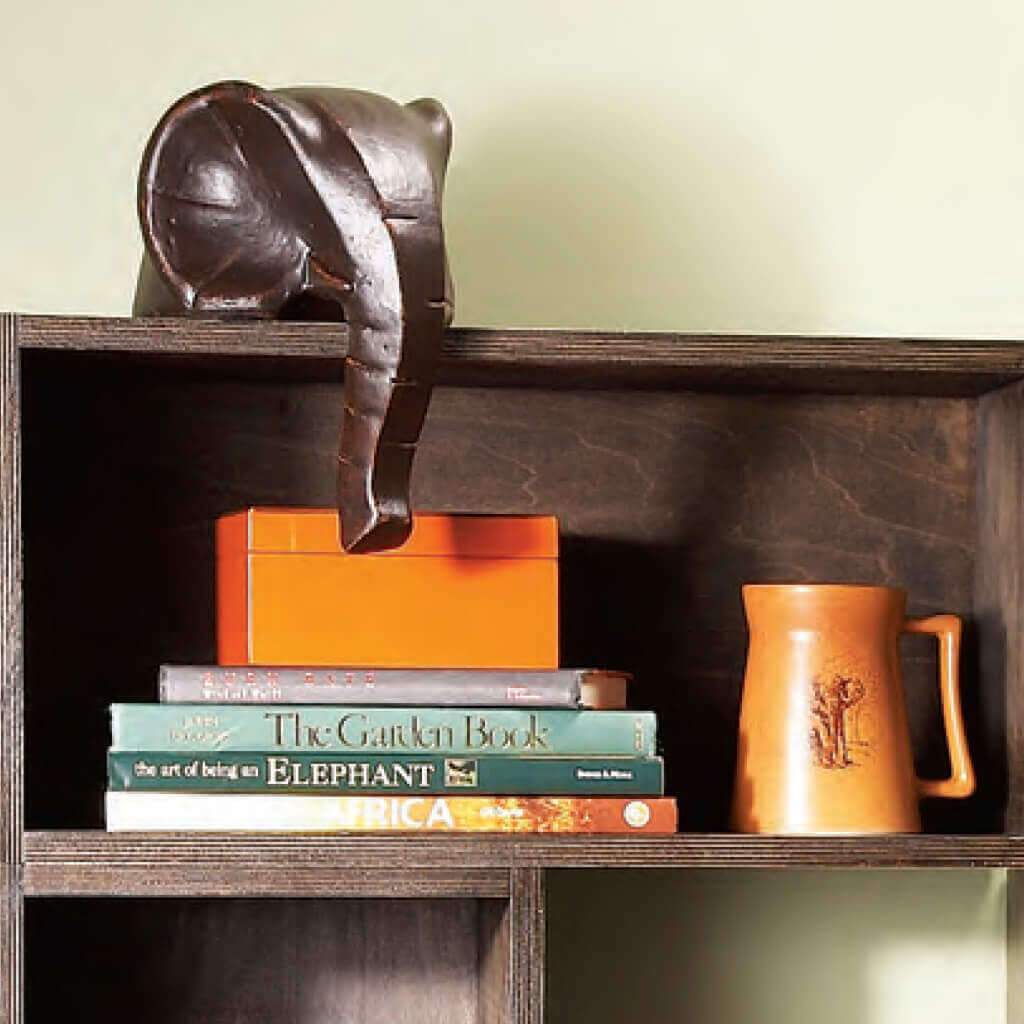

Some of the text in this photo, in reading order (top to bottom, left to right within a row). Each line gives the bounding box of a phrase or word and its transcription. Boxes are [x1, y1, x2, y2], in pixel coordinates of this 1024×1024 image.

[264, 711, 331, 747] The
[337, 711, 454, 749] Garden
[463, 713, 549, 749] Book
[133, 760, 156, 777] the
[184, 760, 199, 777] of
[201, 760, 239, 780] being
[266, 756, 435, 788] ELEPHANT
